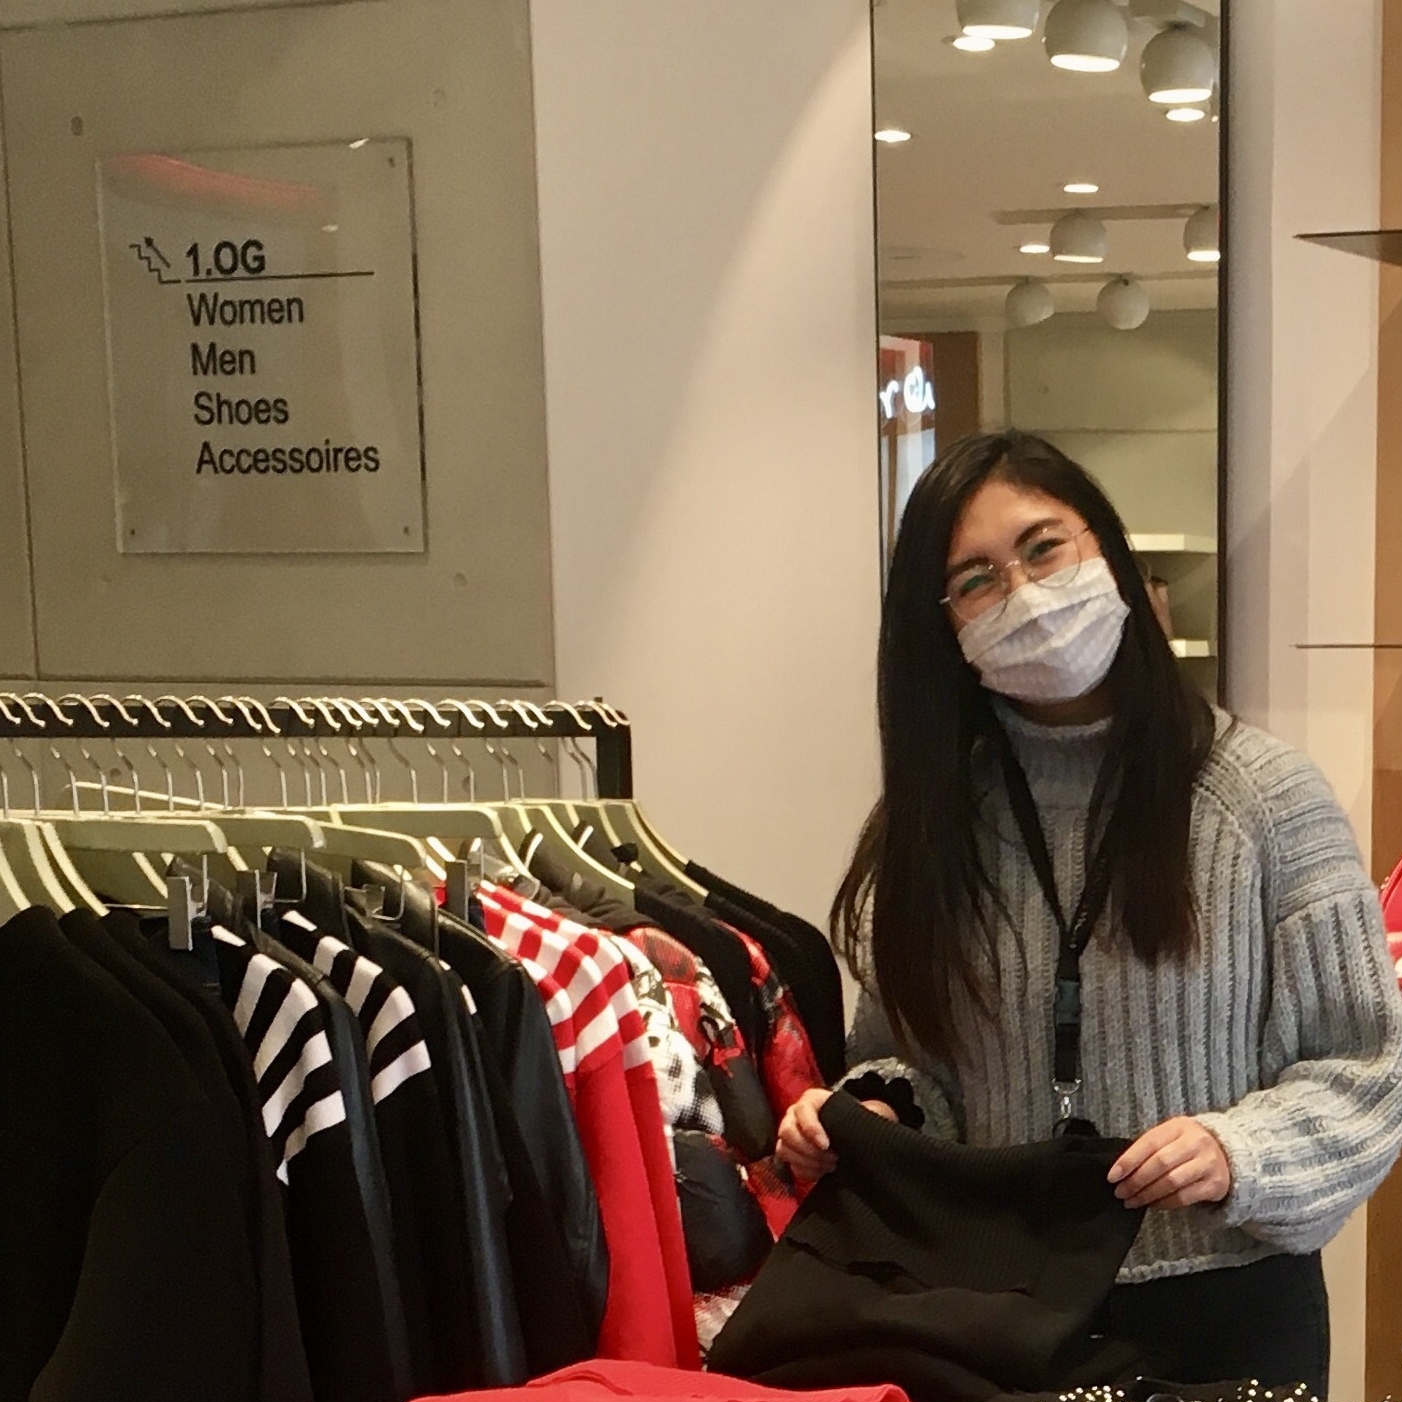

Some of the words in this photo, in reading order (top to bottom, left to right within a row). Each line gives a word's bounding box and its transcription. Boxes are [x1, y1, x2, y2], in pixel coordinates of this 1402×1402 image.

[186, 239, 266, 276] 1.OG
[186, 292, 304, 327] Women
[190, 342, 256, 376] Men
[193, 391, 289, 426] Shoes
[196, 438, 380, 475] Accessoires
